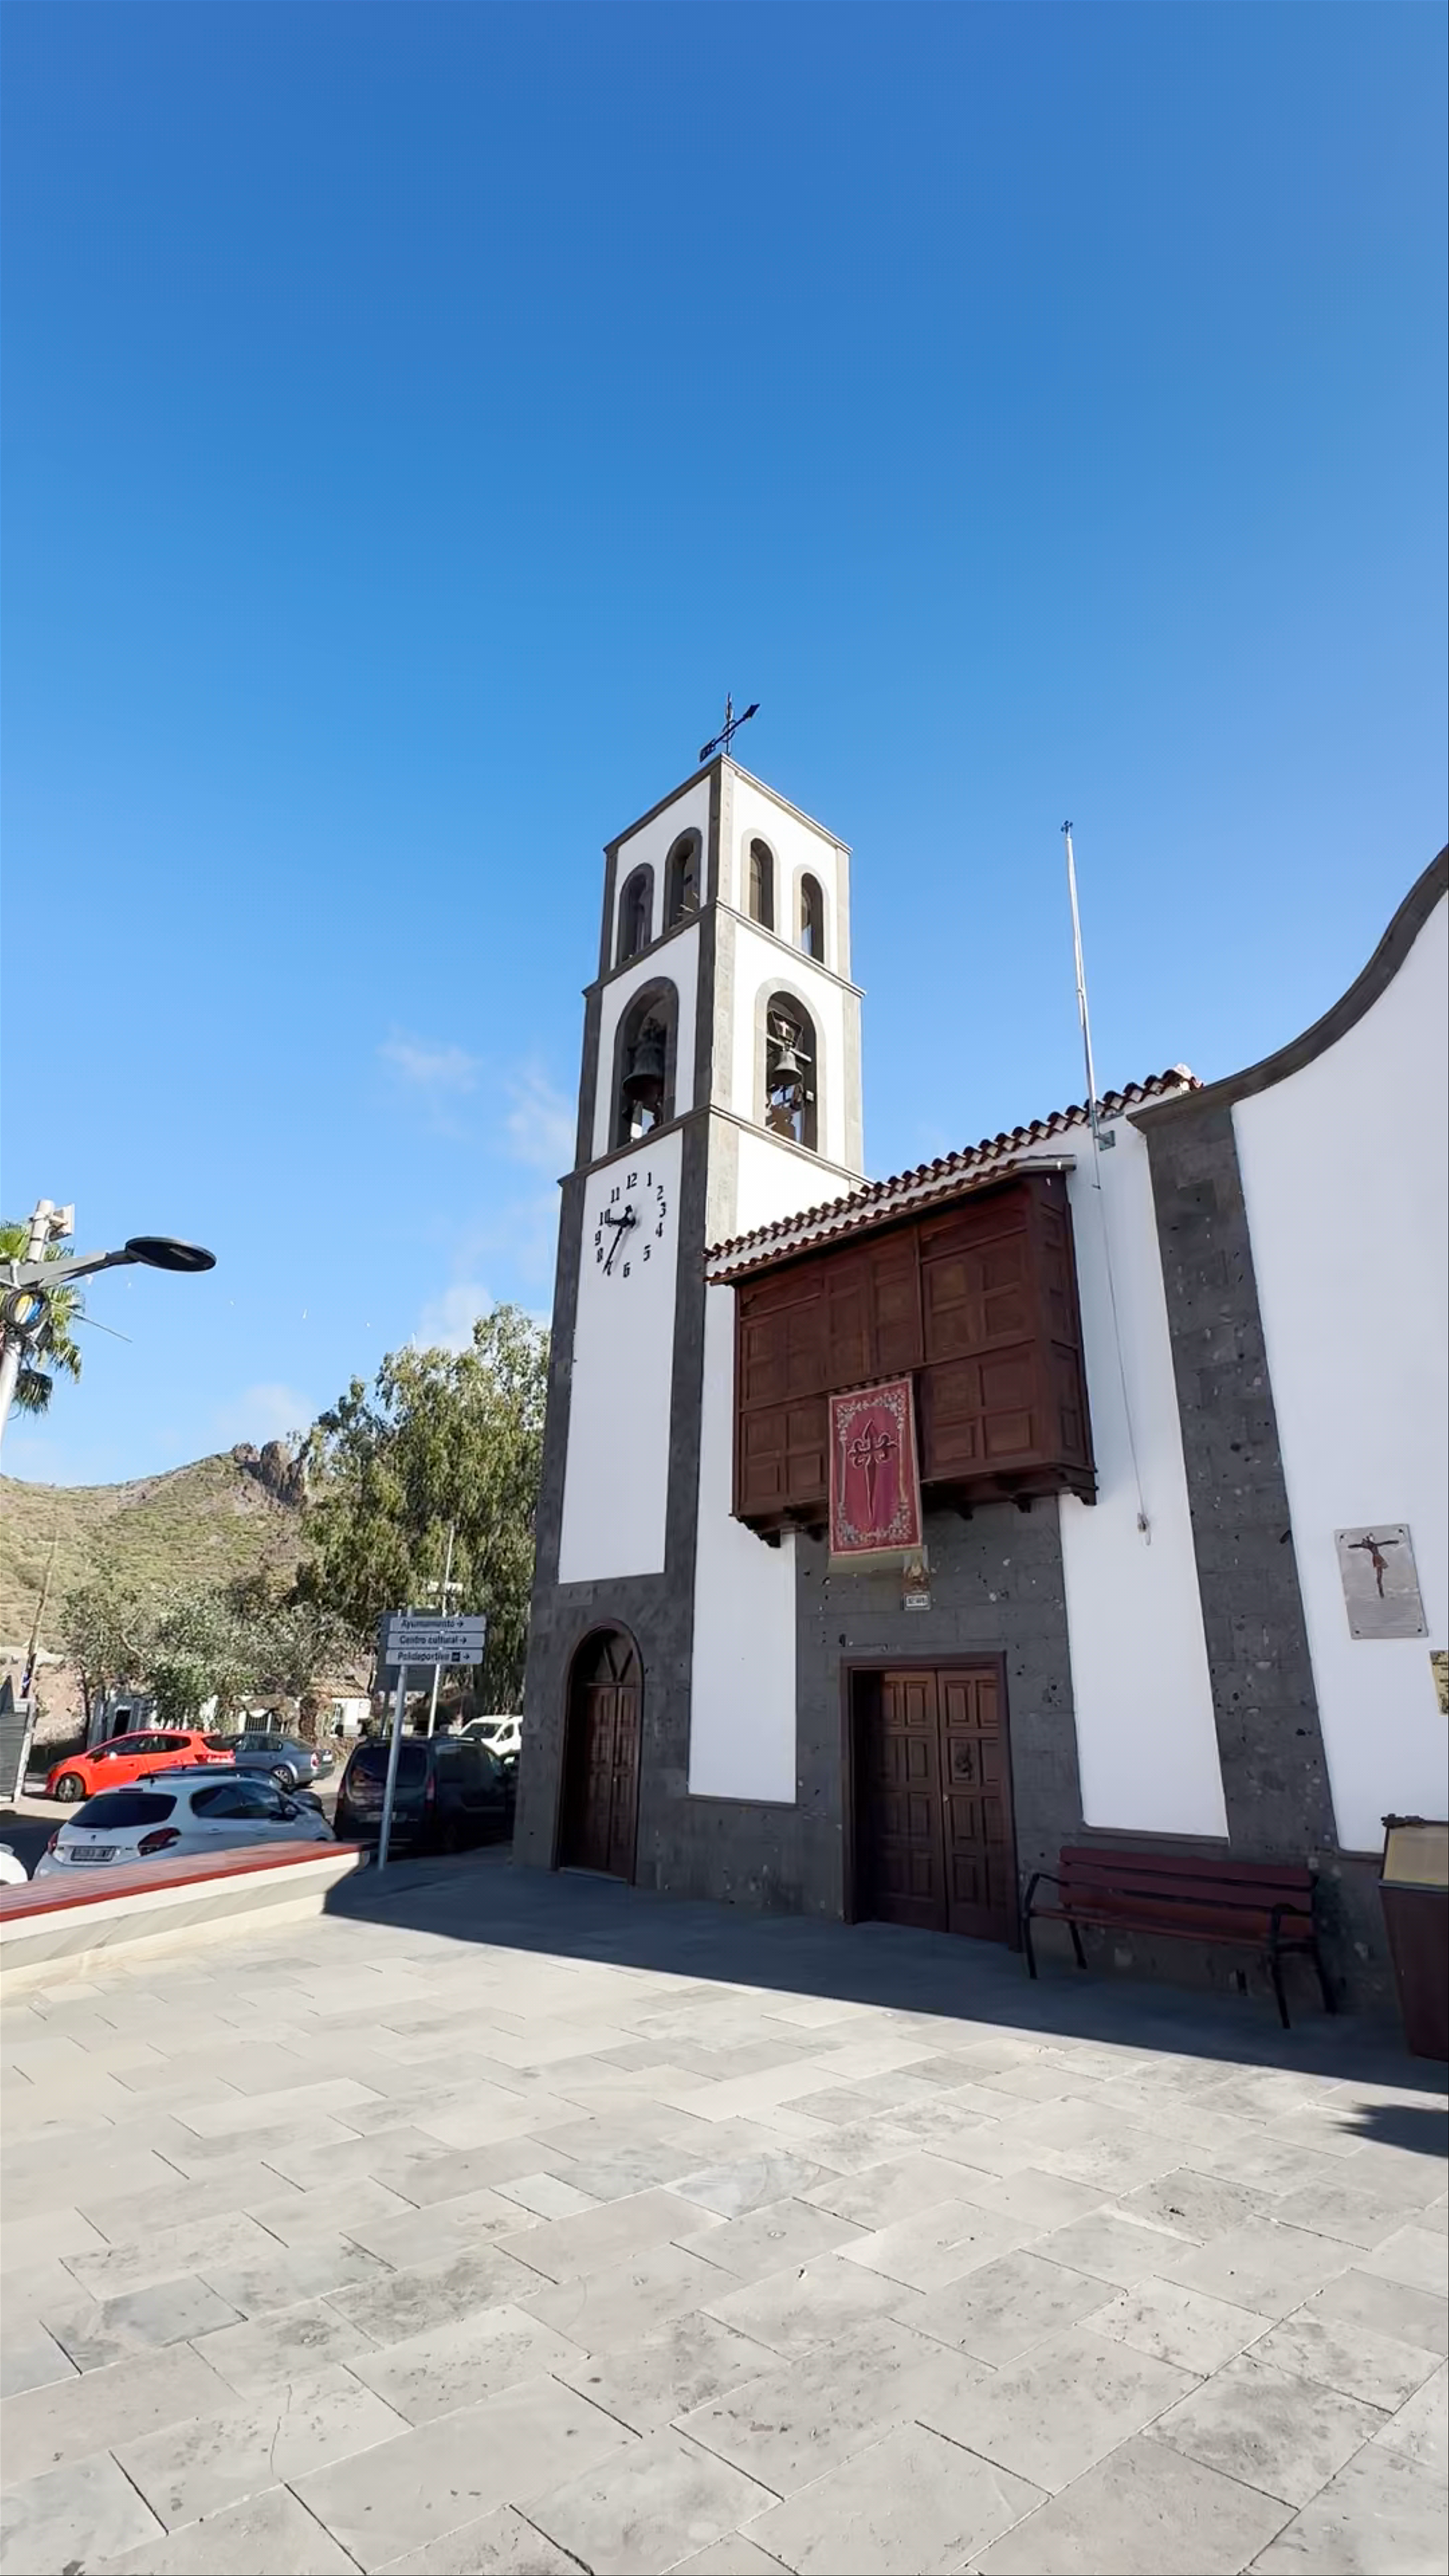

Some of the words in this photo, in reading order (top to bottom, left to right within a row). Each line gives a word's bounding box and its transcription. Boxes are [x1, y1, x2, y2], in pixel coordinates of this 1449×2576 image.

[626, 1172, 637, 1189] 12
[647, 1172, 652, 1187] 1
[611, 1187, 620, 1203] 11
[657, 1185, 663, 1201] 2
[660, 1201, 666, 1218] 3
[655, 1222, 663, 1237] 4
[595, 1230, 601, 1246] 9
[597, 1247, 603, 1263] 8
[643, 1244, 651, 1261] 5
[623, 1262, 630, 1278] 6
[399, 1635, 426, 1644] Centro
[428, 1635, 458, 1644] cultural
